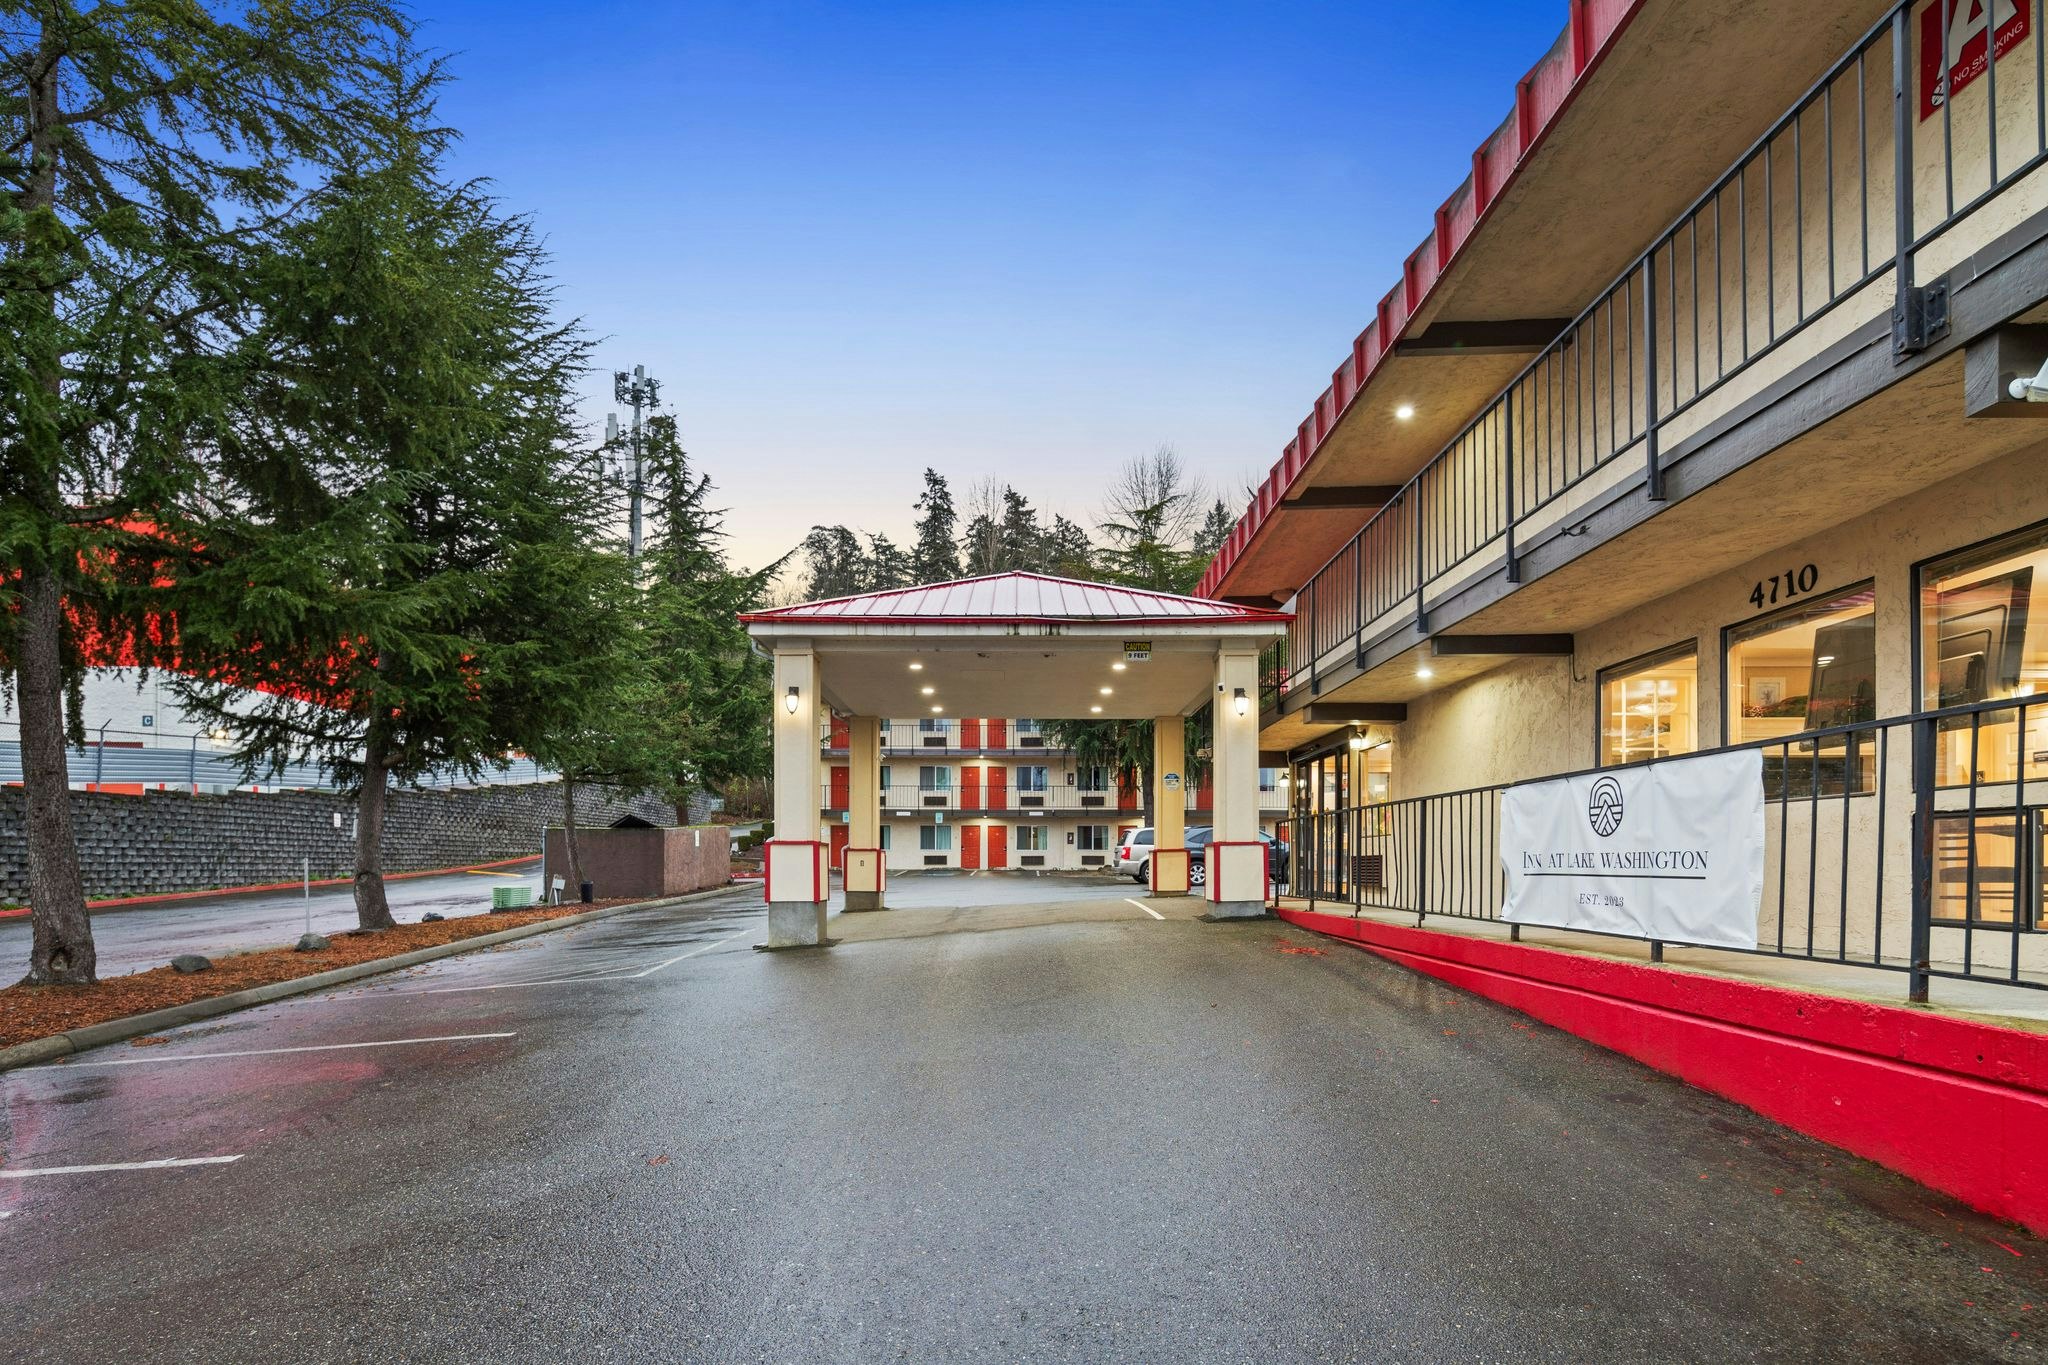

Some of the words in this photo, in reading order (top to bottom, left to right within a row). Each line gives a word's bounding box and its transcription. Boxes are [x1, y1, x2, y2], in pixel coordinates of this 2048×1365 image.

[1953, 67, 1970, 85] NO
[1972, 21, 2023, 70] SMKING
[1749, 564, 1818, 609] 4710
[145, 716, 151, 725] C
[1548, 852, 1565, 869] AT
[1567, 852, 1595, 869] LAKE
[1600, 850, 1709, 870] WASHINGTON
[1579, 893, 1601, 905] EST.
